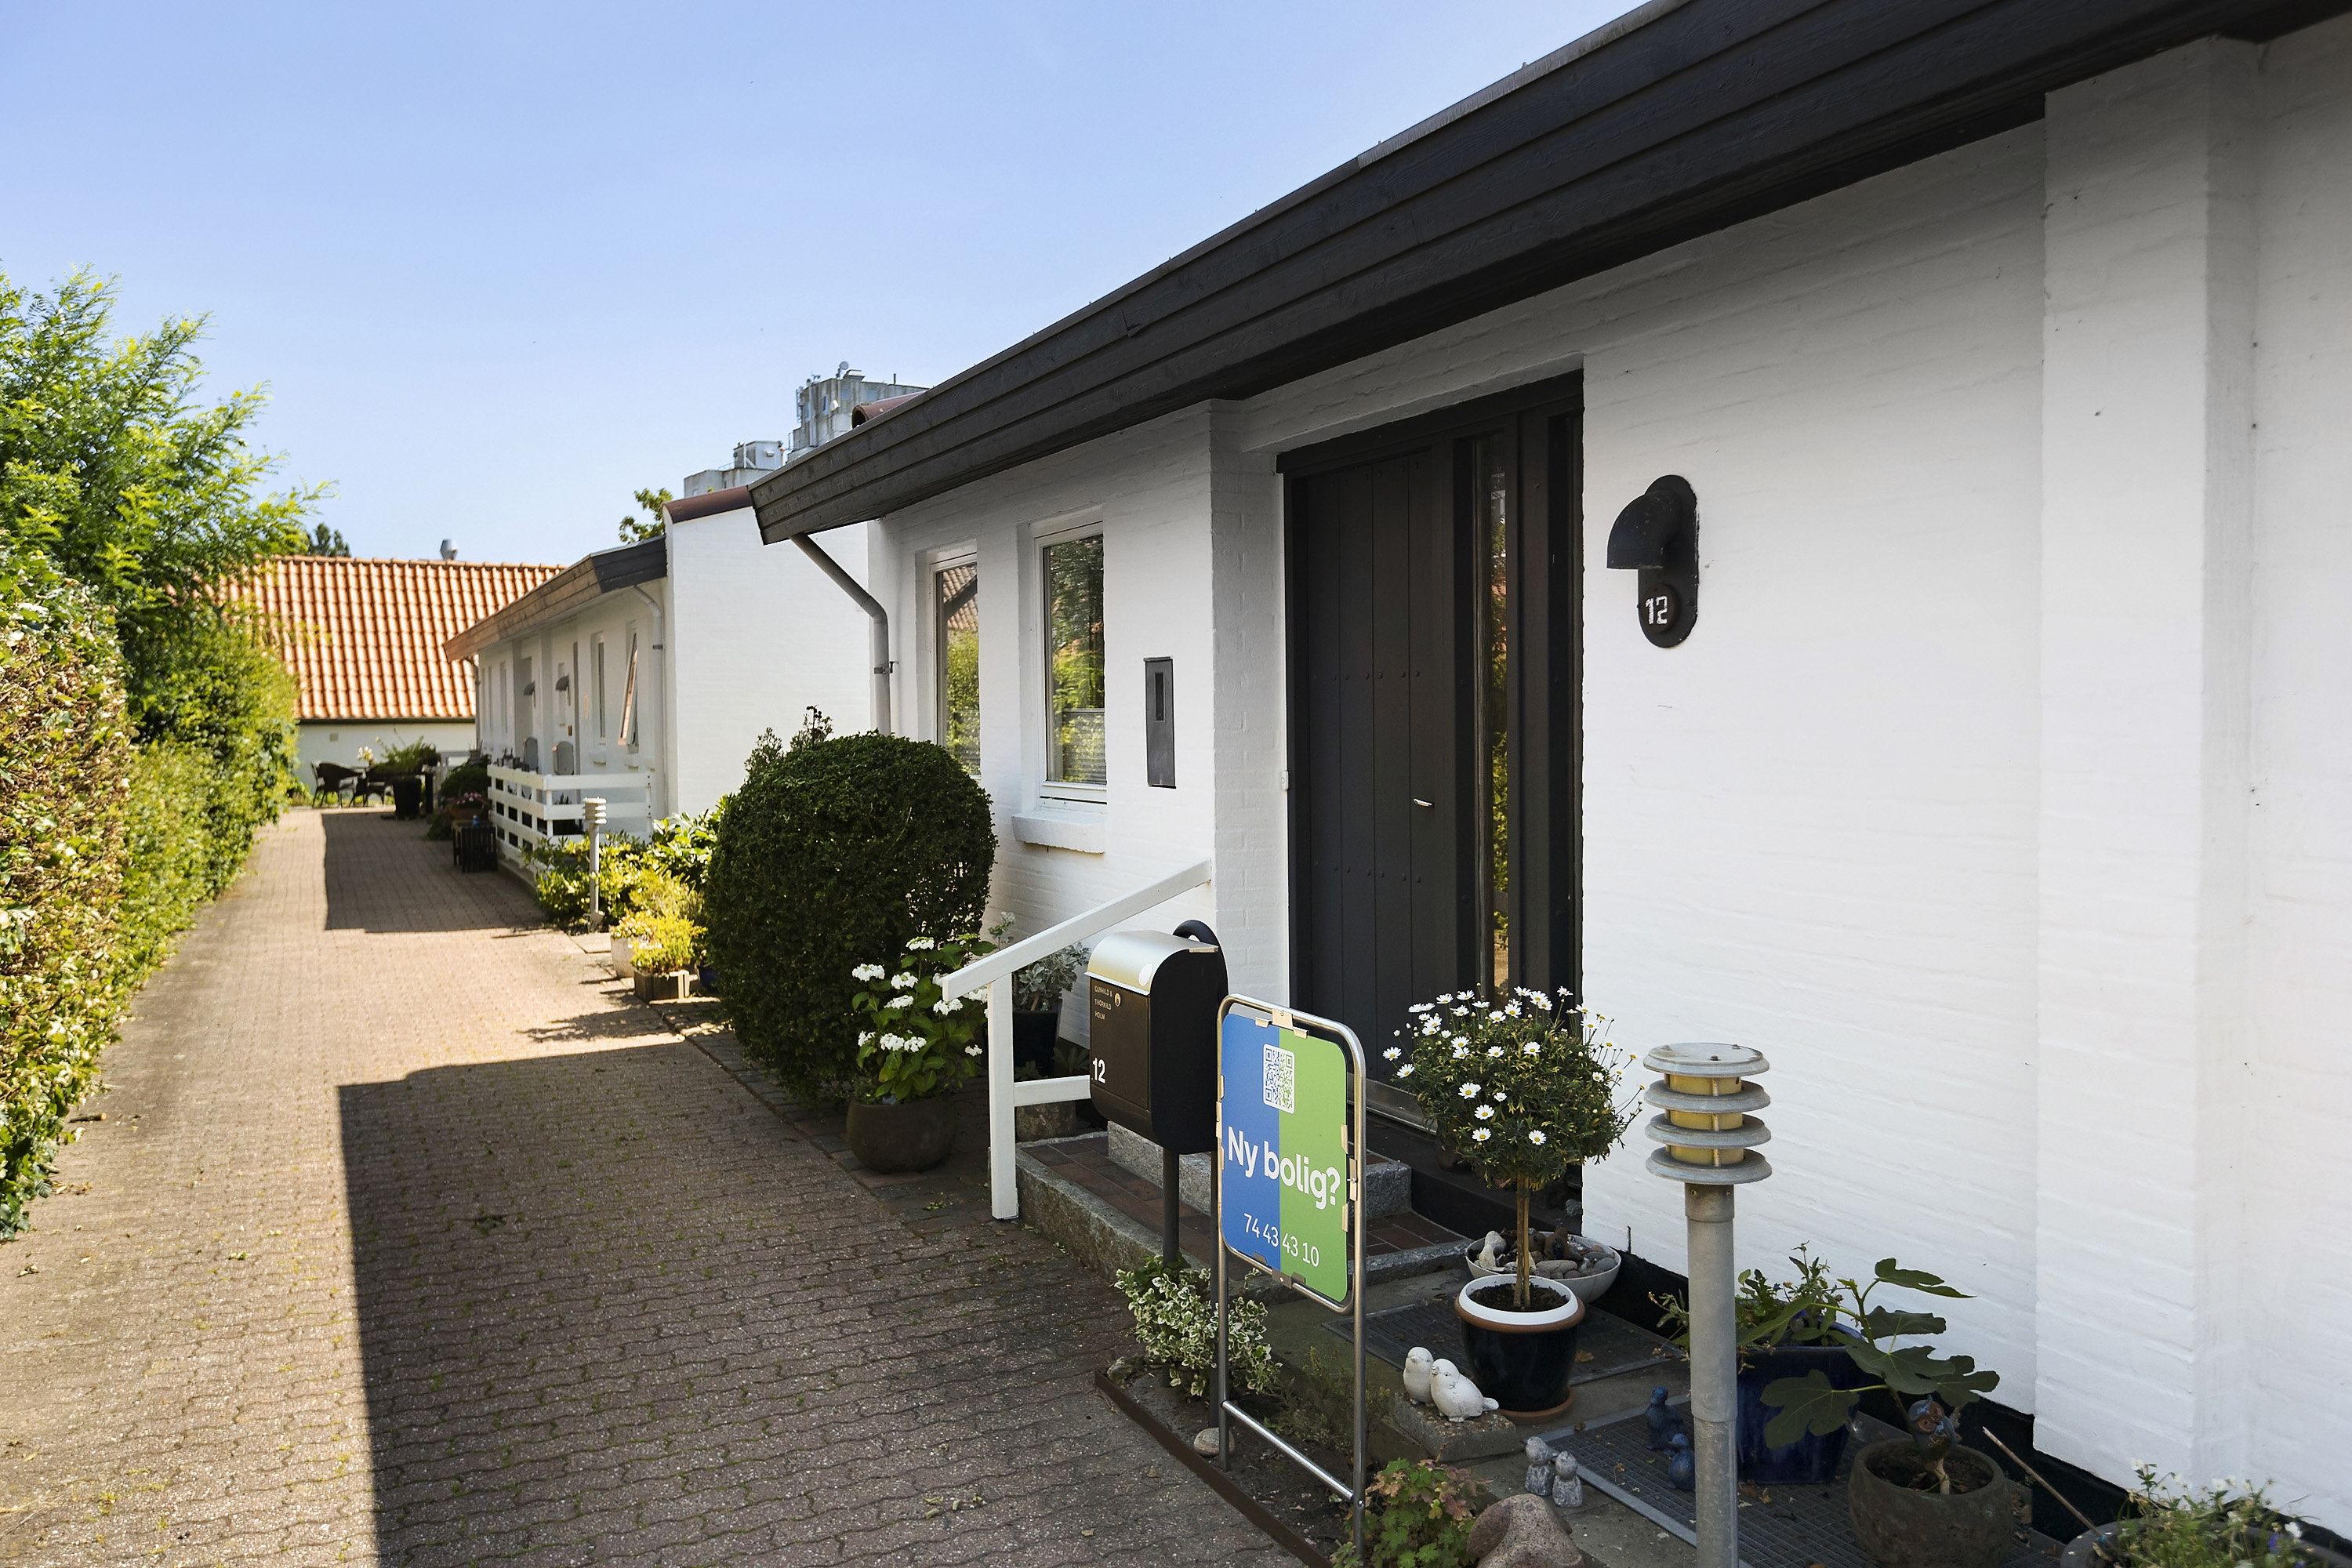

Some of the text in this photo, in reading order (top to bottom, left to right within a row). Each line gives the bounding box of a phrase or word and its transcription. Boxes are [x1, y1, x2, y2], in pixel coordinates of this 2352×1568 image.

[1646, 596, 1668, 625] 12
[1092, 1058, 1106, 1083] 12
[1228, 1126, 1341, 1210] Ny bolig?
[1244, 1213, 1319, 1267] 74 43 43 10
